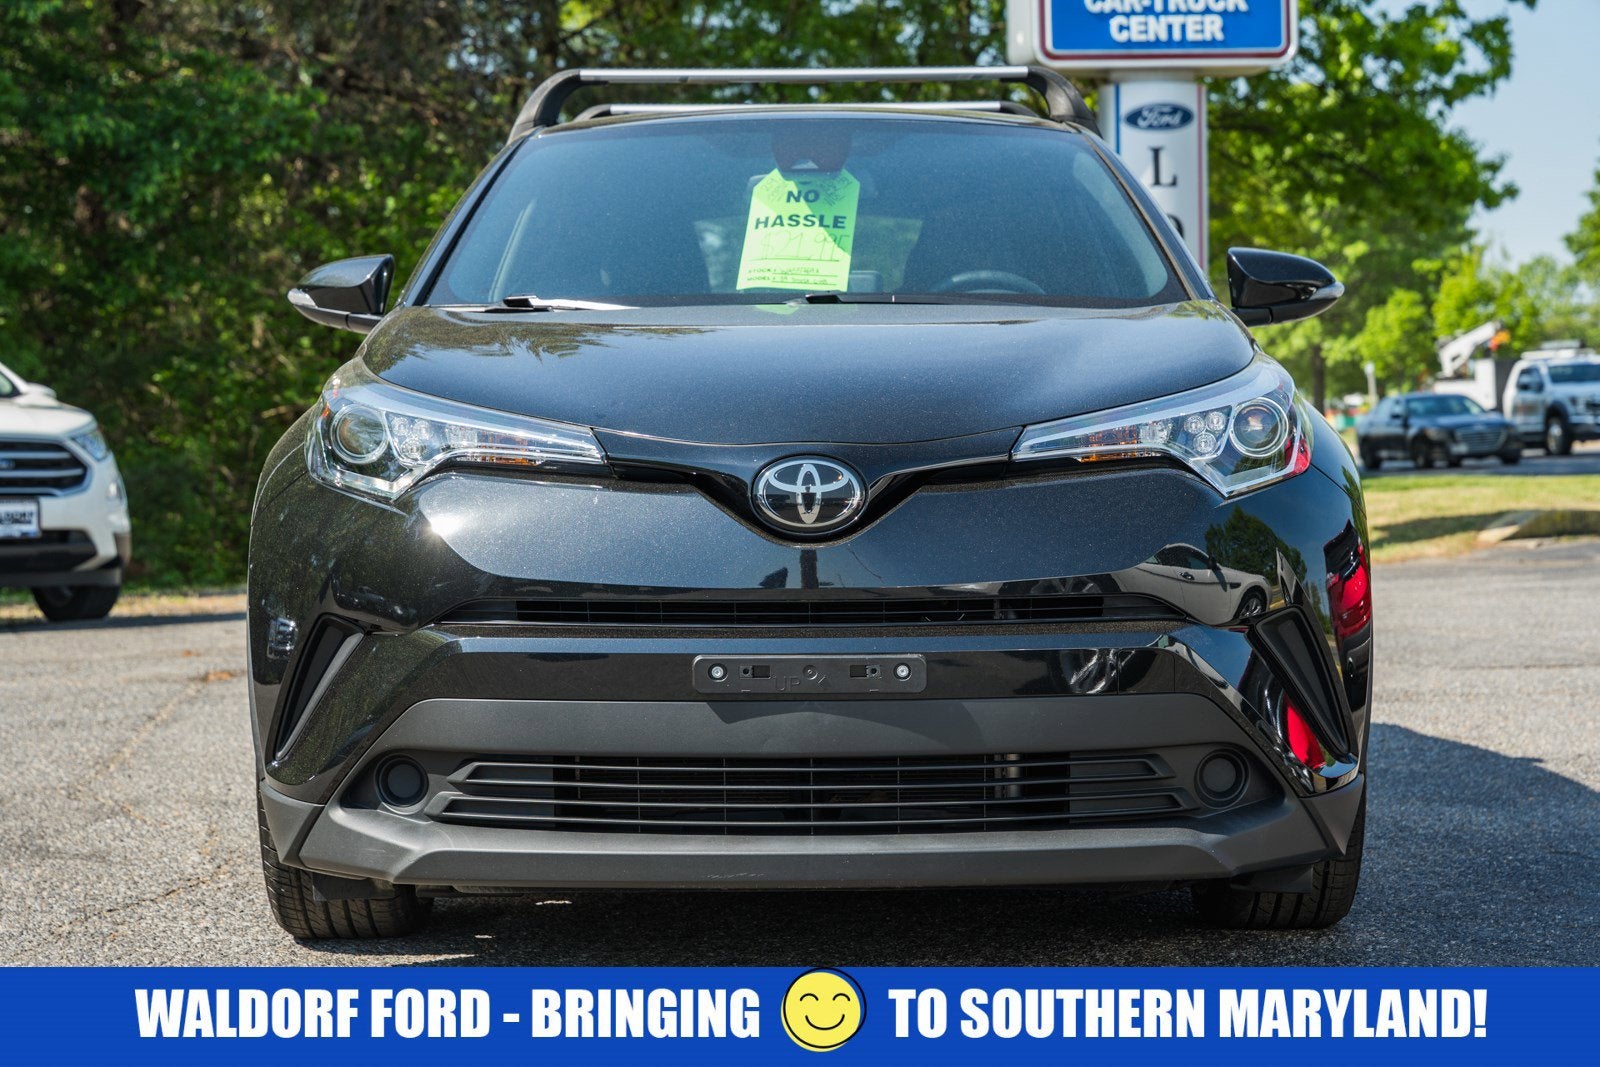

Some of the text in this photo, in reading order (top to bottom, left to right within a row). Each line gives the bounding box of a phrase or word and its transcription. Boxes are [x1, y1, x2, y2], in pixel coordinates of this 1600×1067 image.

[1109, 14, 1225, 42] CENTER
[1136, 105, 1184, 129] Ford
[786, 189, 820, 204] NO
[754, 213, 847, 230] HASSLE
